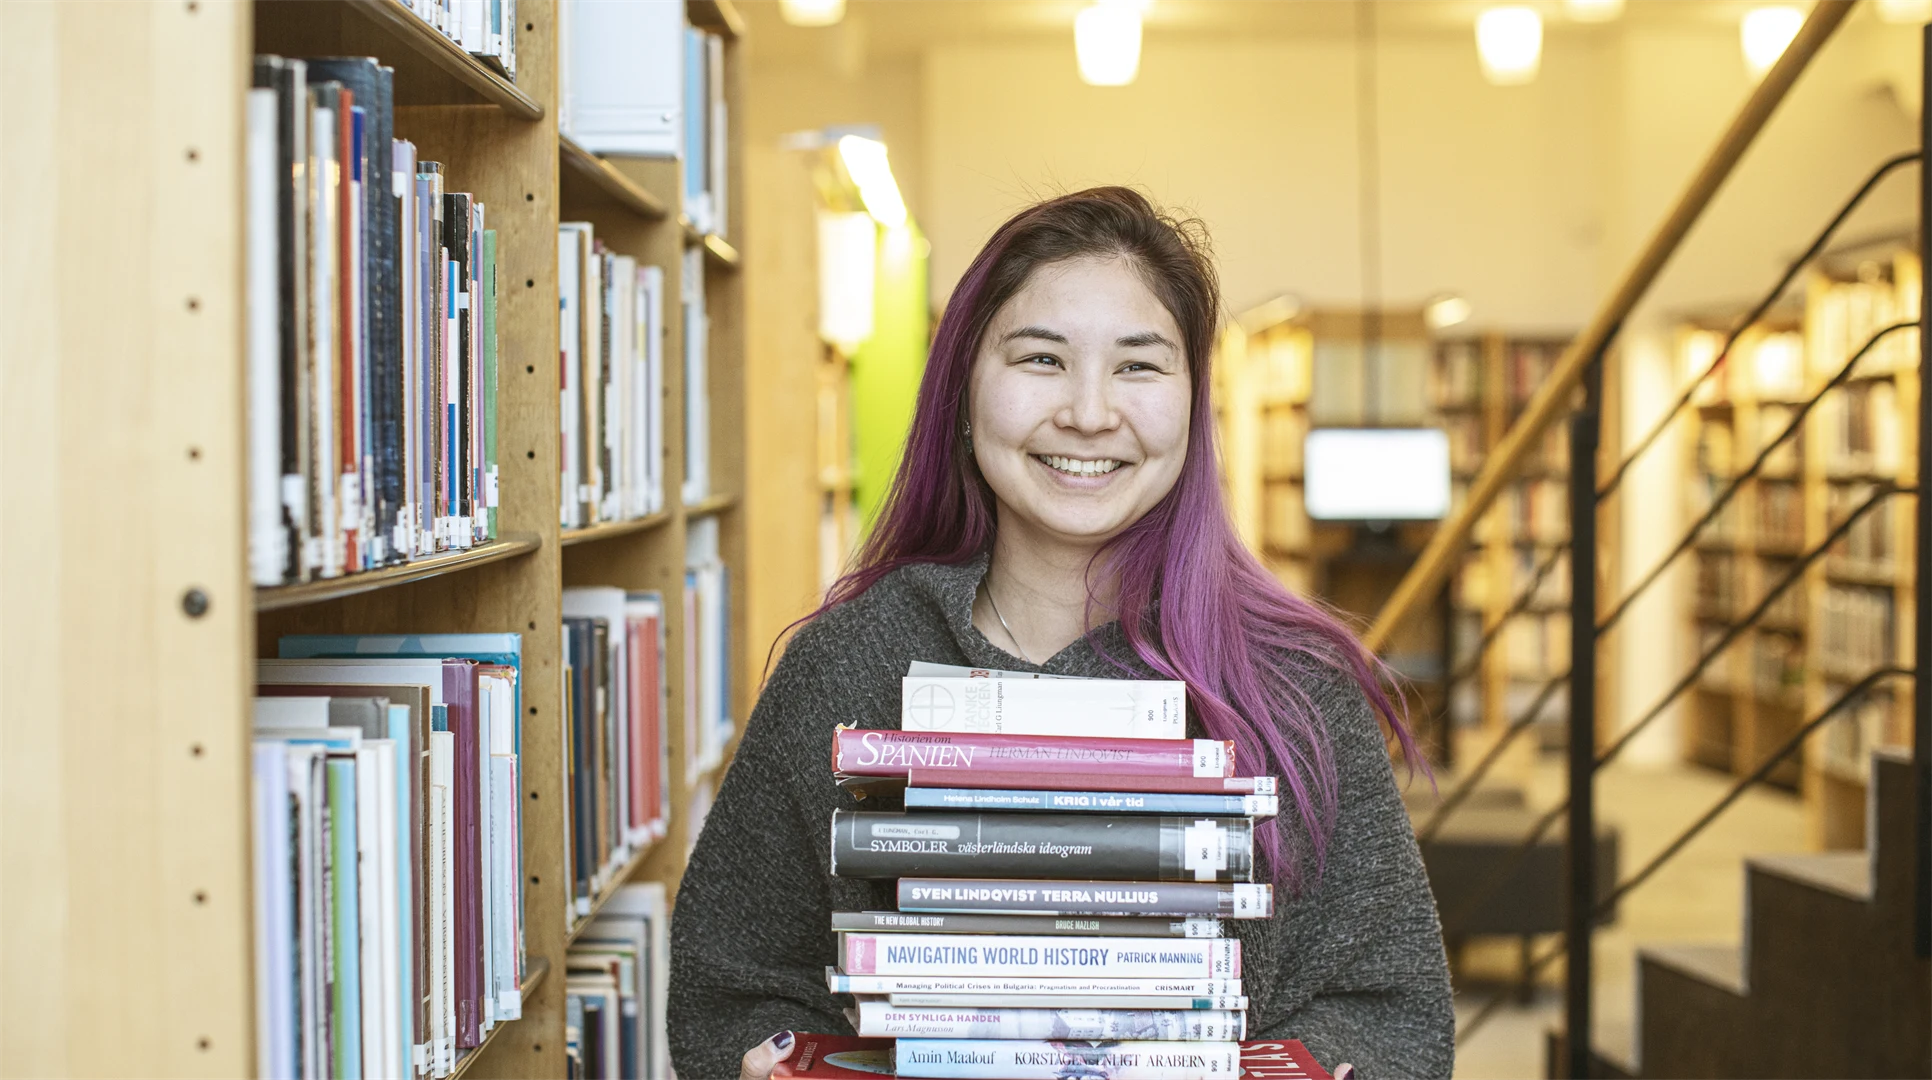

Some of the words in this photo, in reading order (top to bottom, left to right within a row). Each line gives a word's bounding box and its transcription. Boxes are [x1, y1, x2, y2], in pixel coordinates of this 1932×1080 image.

[883, 733, 931, 744] Historien
[989, 746, 1050, 759] HERMAN
[1057, 749, 1134, 763] LINDQVIST
[943, 794, 973, 803] Helena
[974, 795, 1012, 804] Lindholm
[1012, 796, 1040, 804] Schulz
[1054, 795, 1090, 806] KRIG
[1099, 795, 1123, 807] vår
[1125, 796, 1144, 808] tid
[870, 839, 948, 853] SYMBOLER
[957, 841, 1036, 854] västerländska
[1039, 842, 1092, 859] ideogram
[911, 887, 952, 900] SVEN
[955, 888, 1037, 902] LINDQVIST
[1042, 890, 1092, 902] TERRA
[1094, 891, 1159, 904] NULLIUS
[874, 915, 886, 925] THE
[886, 916, 898, 926] NEW
[899, 916, 920, 926] GLOBAL
[921, 917, 945, 927] HISTORY
[1055, 920, 1075, 930] BRUCE
[1075, 920, 1100, 931] MAZLISH
[887, 945, 978, 965] NAVIGATING
[983, 946, 1039, 965] WORLD
[1044, 947, 1109, 966] HISTORY
[1117, 951, 1157, 964] PATRICK
[1159, 952, 1203, 964] MANNING
[896, 982, 932, 990] Managing
[1003, 983, 1037, 991] Bulgaria:
[885, 1013, 905, 1021] DEN
[908, 1014, 954, 1022] SYNLIGA
[957, 1015, 1000, 1023] HANDEN
[884, 1023, 905, 1032] Lars
[906, 1024, 954, 1034] Magnusson
[908, 1050, 942, 1063] Amin
[946, 1050, 996, 1064] Maalouf
[1146, 1054, 1206, 1068] ARABERN
[1240, 1043, 1313, 1080] TLAS
